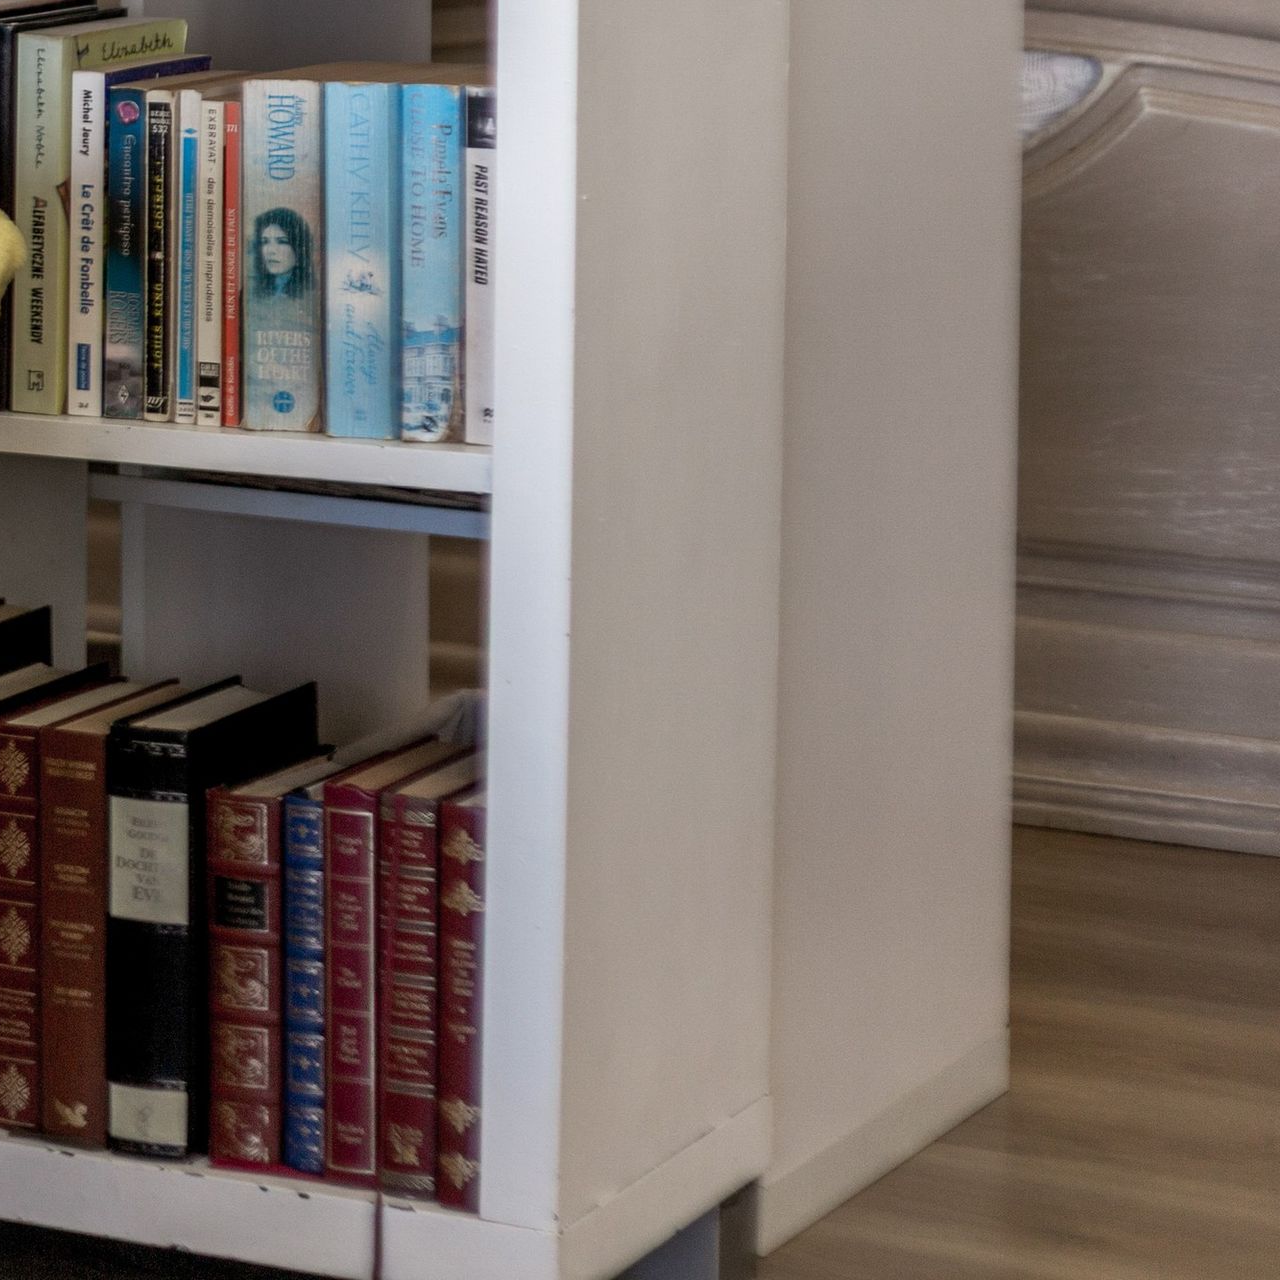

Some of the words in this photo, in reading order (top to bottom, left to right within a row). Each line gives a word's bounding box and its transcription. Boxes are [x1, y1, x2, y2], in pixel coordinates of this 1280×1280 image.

[100, 35, 175, 63] Elizabeth
[81, 88, 93, 126] Michel
[410, 93, 427, 158] CLOSE
[80, 128, 92, 158] Jeury
[207, 108, 217, 164] EXBRAYAT
[266, 93, 297, 182] HOWARD
[347, 92, 369, 177] CATHY
[431, 123, 453, 183] Pamela
[121, 133, 137, 195] Encontro
[205, 177, 216, 194] des
[410, 167, 427, 196] TO
[473, 165, 489, 195] PAST
[82, 183, 94, 203] Le
[432, 183, 453, 239] Evans
[30, 195, 48, 280] ALFABETYCZNE
[82, 205, 95, 237] Crêt
[116, 200, 135, 256] perigoso
[205, 198, 216, 256] demoiselles
[225, 208, 237, 237] FAUX
[347, 190, 370, 264] KELLY
[410, 204, 427, 269] HOME
[473, 197, 489, 244] REASON
[81, 240, 93, 257] de
[225, 241, 237, 251] DE
[225, 253, 237, 281] USAGE
[473, 247, 489, 285] HATED
[80, 259, 93, 316] Fonbelle
[203, 260, 216, 322] imprudentes
[225, 283, 237, 292] ET
[225, 294, 237, 320] FAUX
[30, 287, 44, 344] WEEKENDY
[108, 291, 128, 345] ROGERS
[128, 292, 140, 345] ROSEMARY
[255, 330, 311, 347] RIVERS
